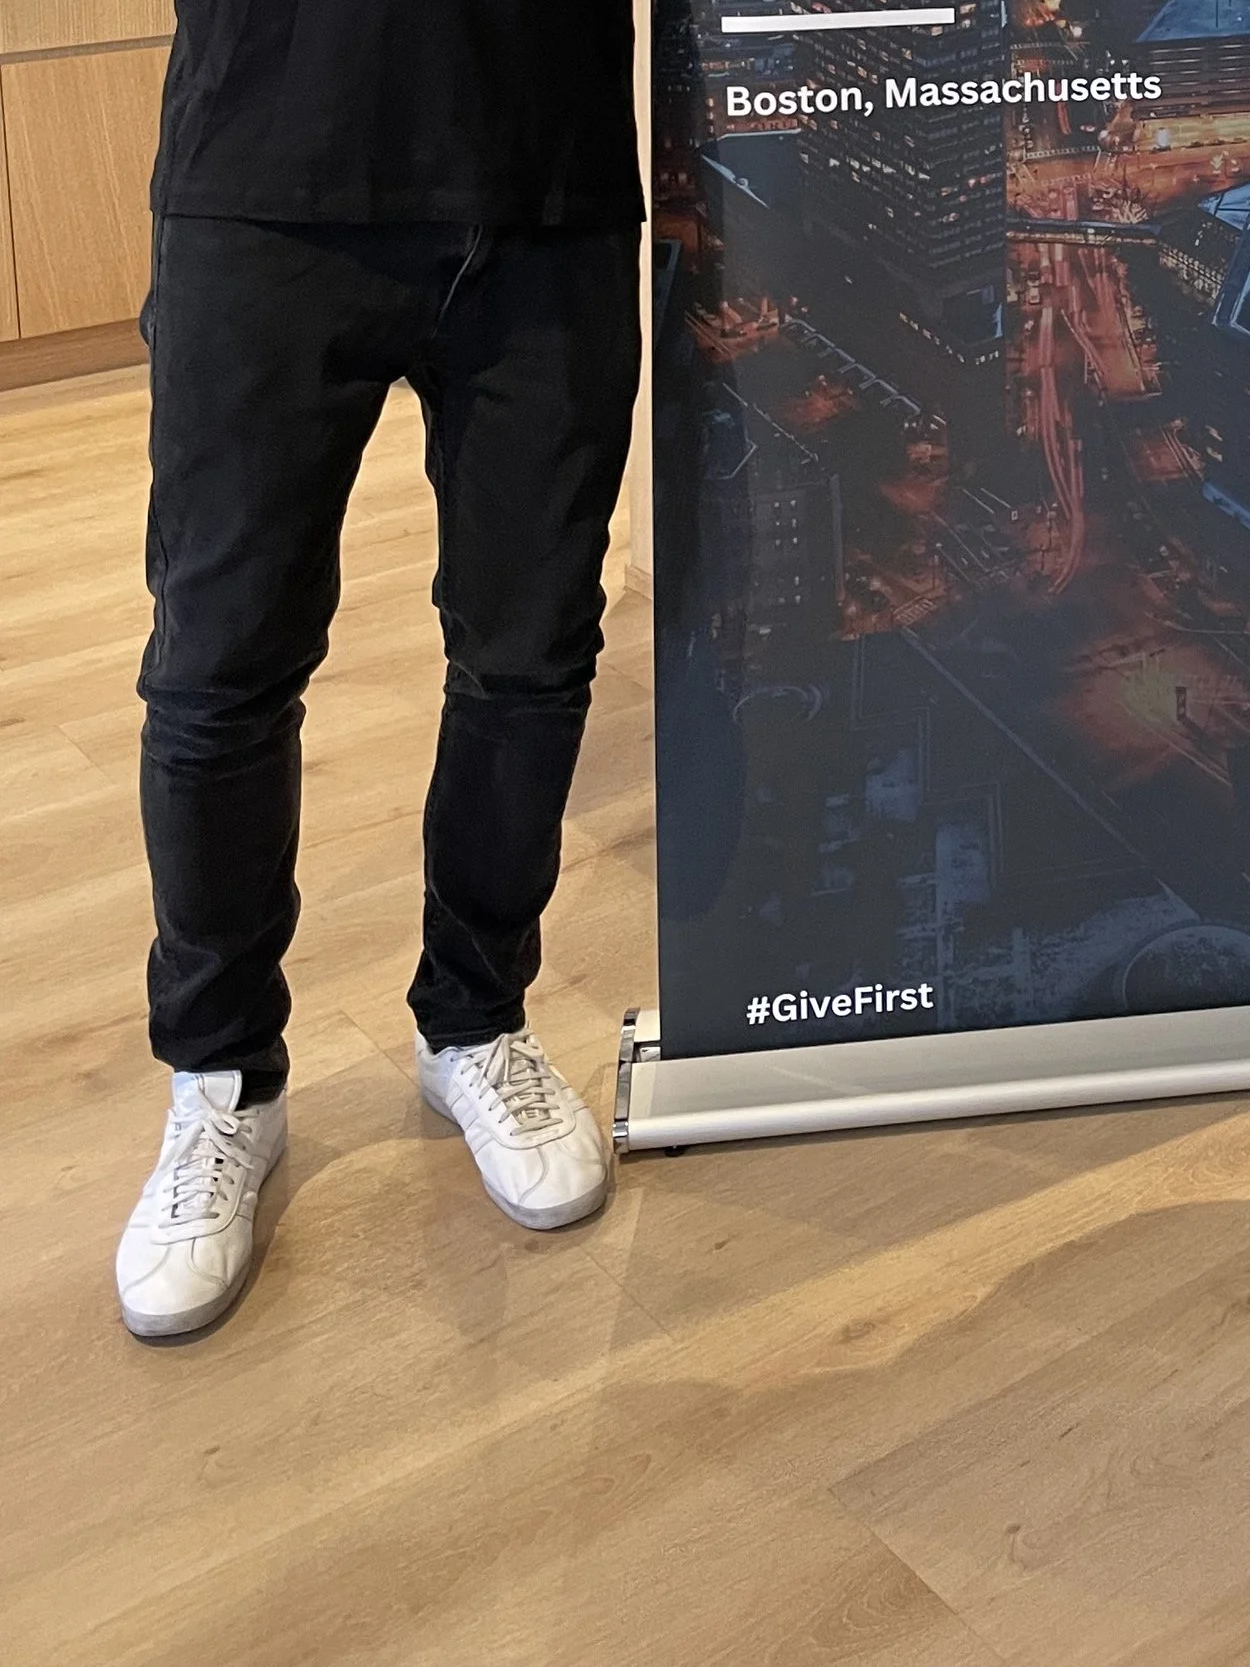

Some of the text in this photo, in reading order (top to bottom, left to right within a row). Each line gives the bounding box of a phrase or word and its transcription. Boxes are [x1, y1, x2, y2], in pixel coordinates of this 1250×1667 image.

[726, 71, 1163, 117] Boston, Massachusetts
[746, 982, 934, 1024] #GiveFirst
